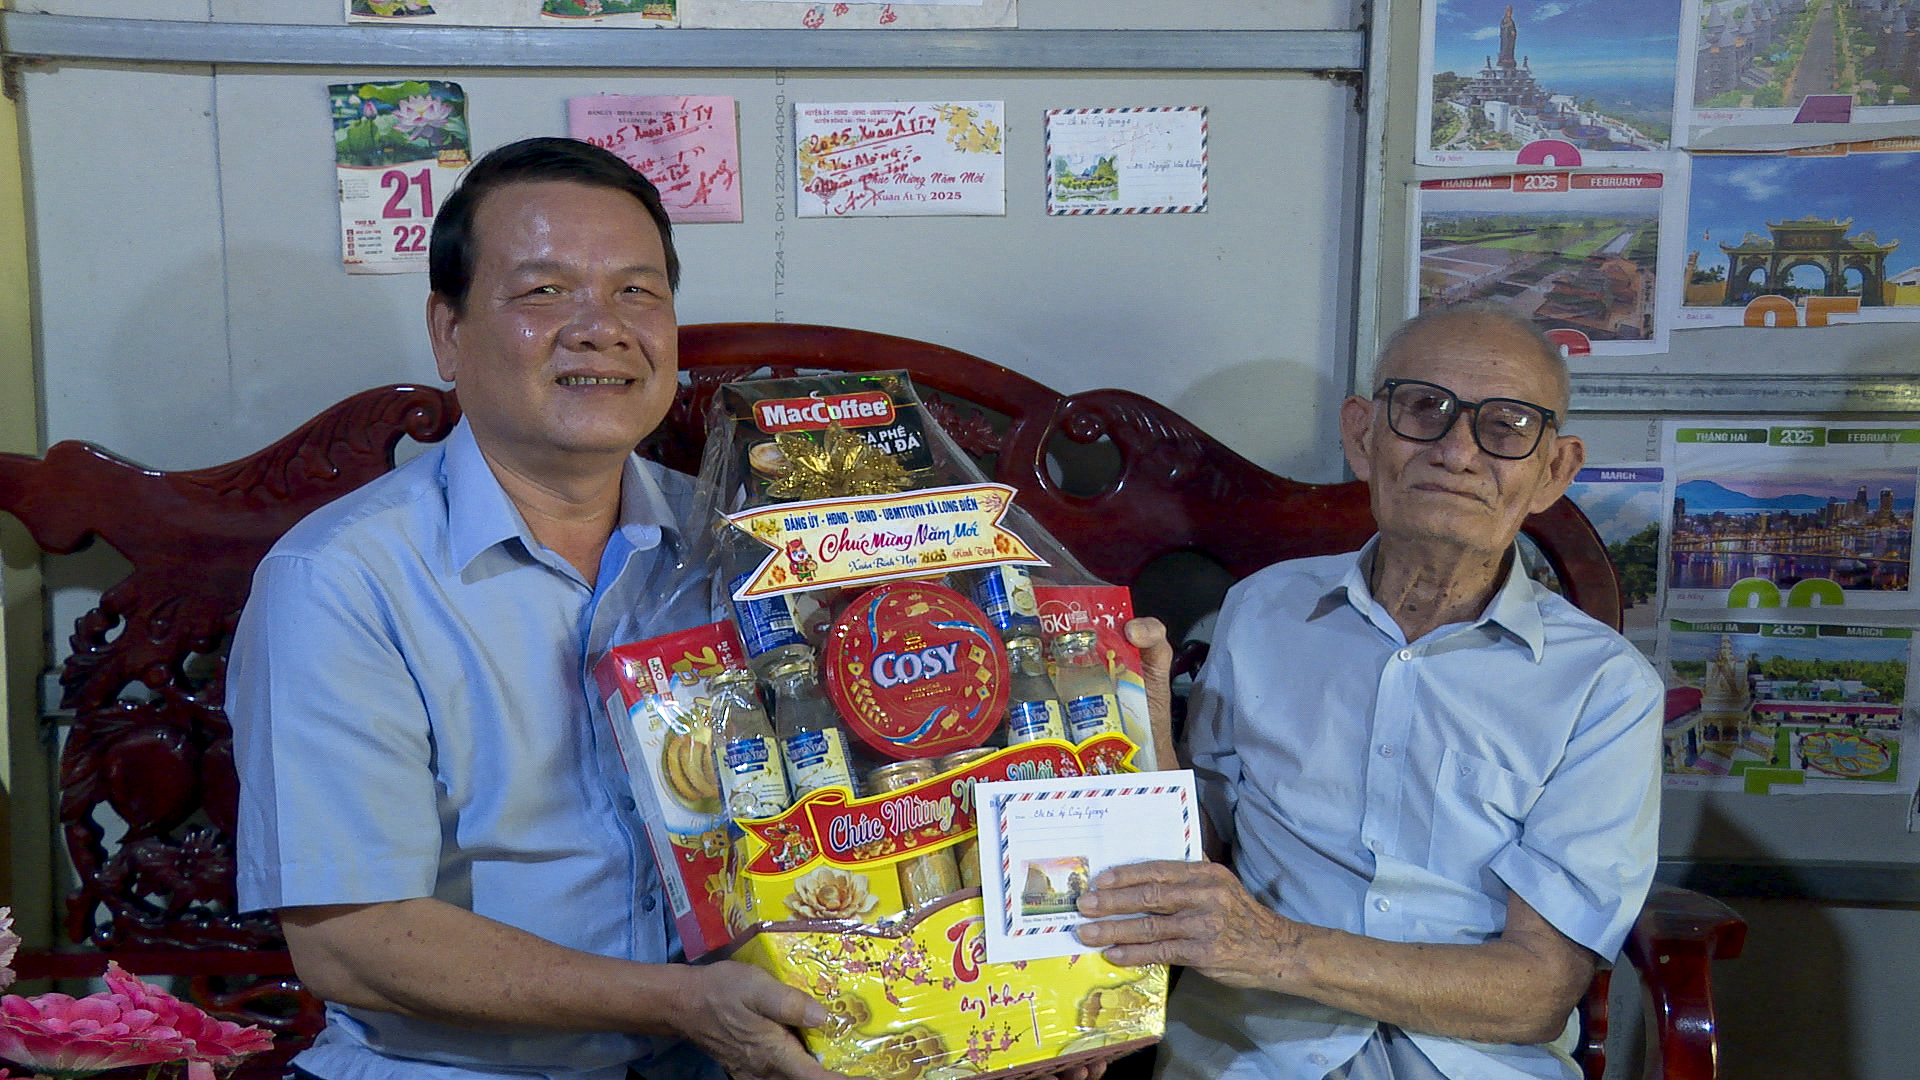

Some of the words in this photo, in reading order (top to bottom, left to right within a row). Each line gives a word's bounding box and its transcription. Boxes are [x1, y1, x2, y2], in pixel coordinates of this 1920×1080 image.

[930, 171, 956, 184] Năm
[959, 171, 985, 184] Mới
[1524, 175, 1558, 190] 2025
[1590, 177, 1642, 188] FEBRUARY
[380, 168, 434, 219] 21
[930, 191, 962, 200] 2025
[393, 224, 427, 253] 22
[761, 398, 888, 427] MacCoffee
[878, 425, 907, 442] PHÊ
[894, 433, 921, 453] ĐÁ
[1729, 432, 1748, 442] HAI
[1780, 430, 1814, 444] 2025
[1847, 433, 1900, 442] FEBRUARY
[1600, 471, 1637, 481] MARCH
[784, 513, 807, 531] ĐẢNG
[827, 511, 849, 526] HĐND
[854, 509, 878, 524] UBND
[882, 502, 927, 521] UBMTTQVN
[939, 499, 959, 513] LONG
[819, 527, 872, 563] Chúc
[871, 531, 913, 552] Mừng
[913, 523, 955, 546] Năm
[953, 521, 979, 539] Mới
[1846, 626, 1884, 638] MARCH
[870, 640, 960, 688] COSY
[829, 809, 886, 853] Chúc
[880, 794, 956, 836] Mừng
